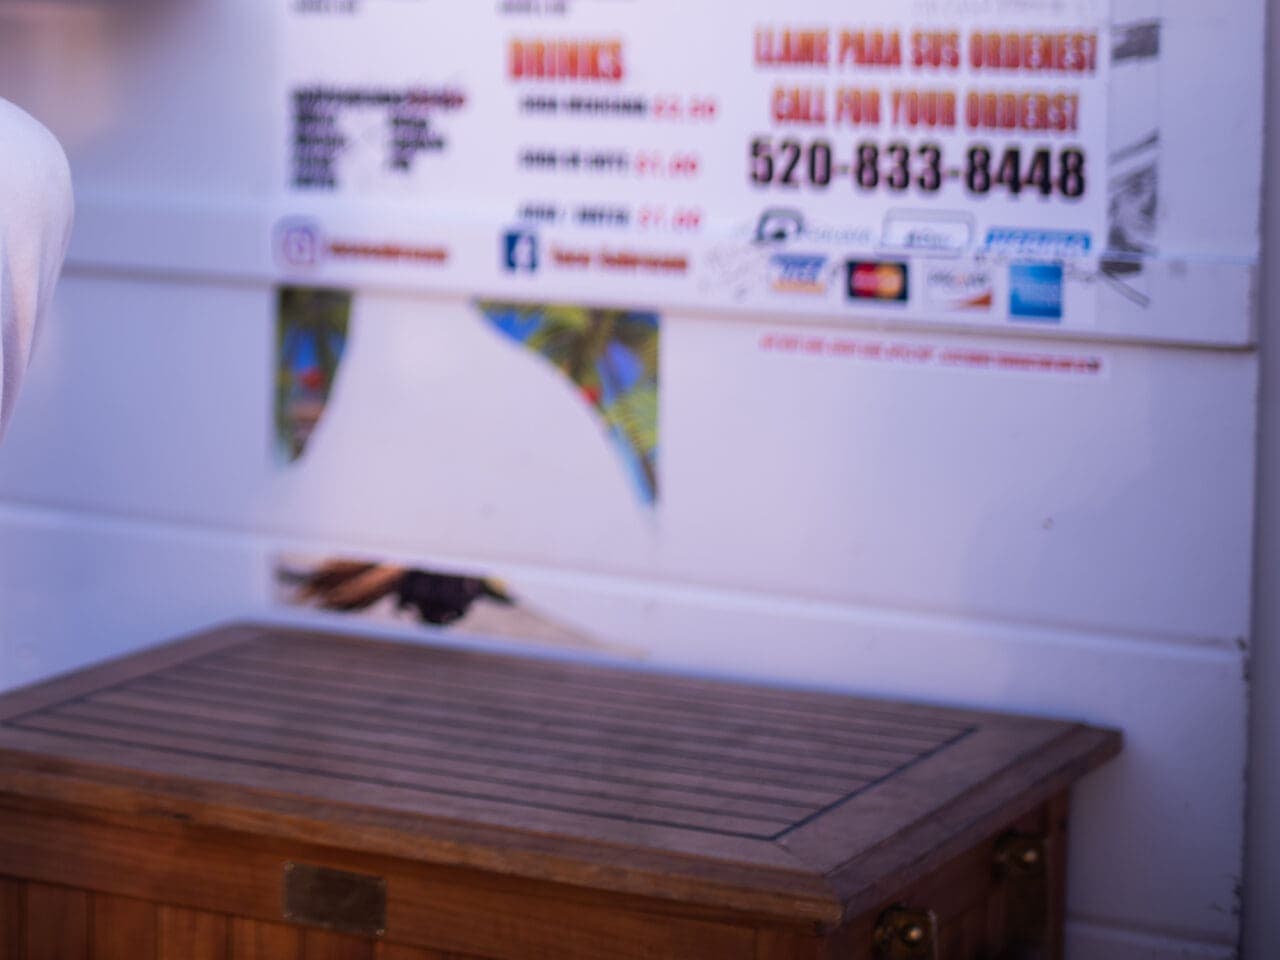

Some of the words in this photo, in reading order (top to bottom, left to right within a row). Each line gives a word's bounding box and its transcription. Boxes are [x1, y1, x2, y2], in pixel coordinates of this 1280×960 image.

[509, 42, 624, 83] DRINKS
[756, 32, 829, 67] LLAME
[839, 32, 902, 69] PARA
[912, 32, 960, 70] SUS
[772, 90, 826, 126] CALL
[836, 90, 881, 127] FOR
[893, 92, 957, 130] YOUR
[752, 143, 1085, 198] 520-833-8448
